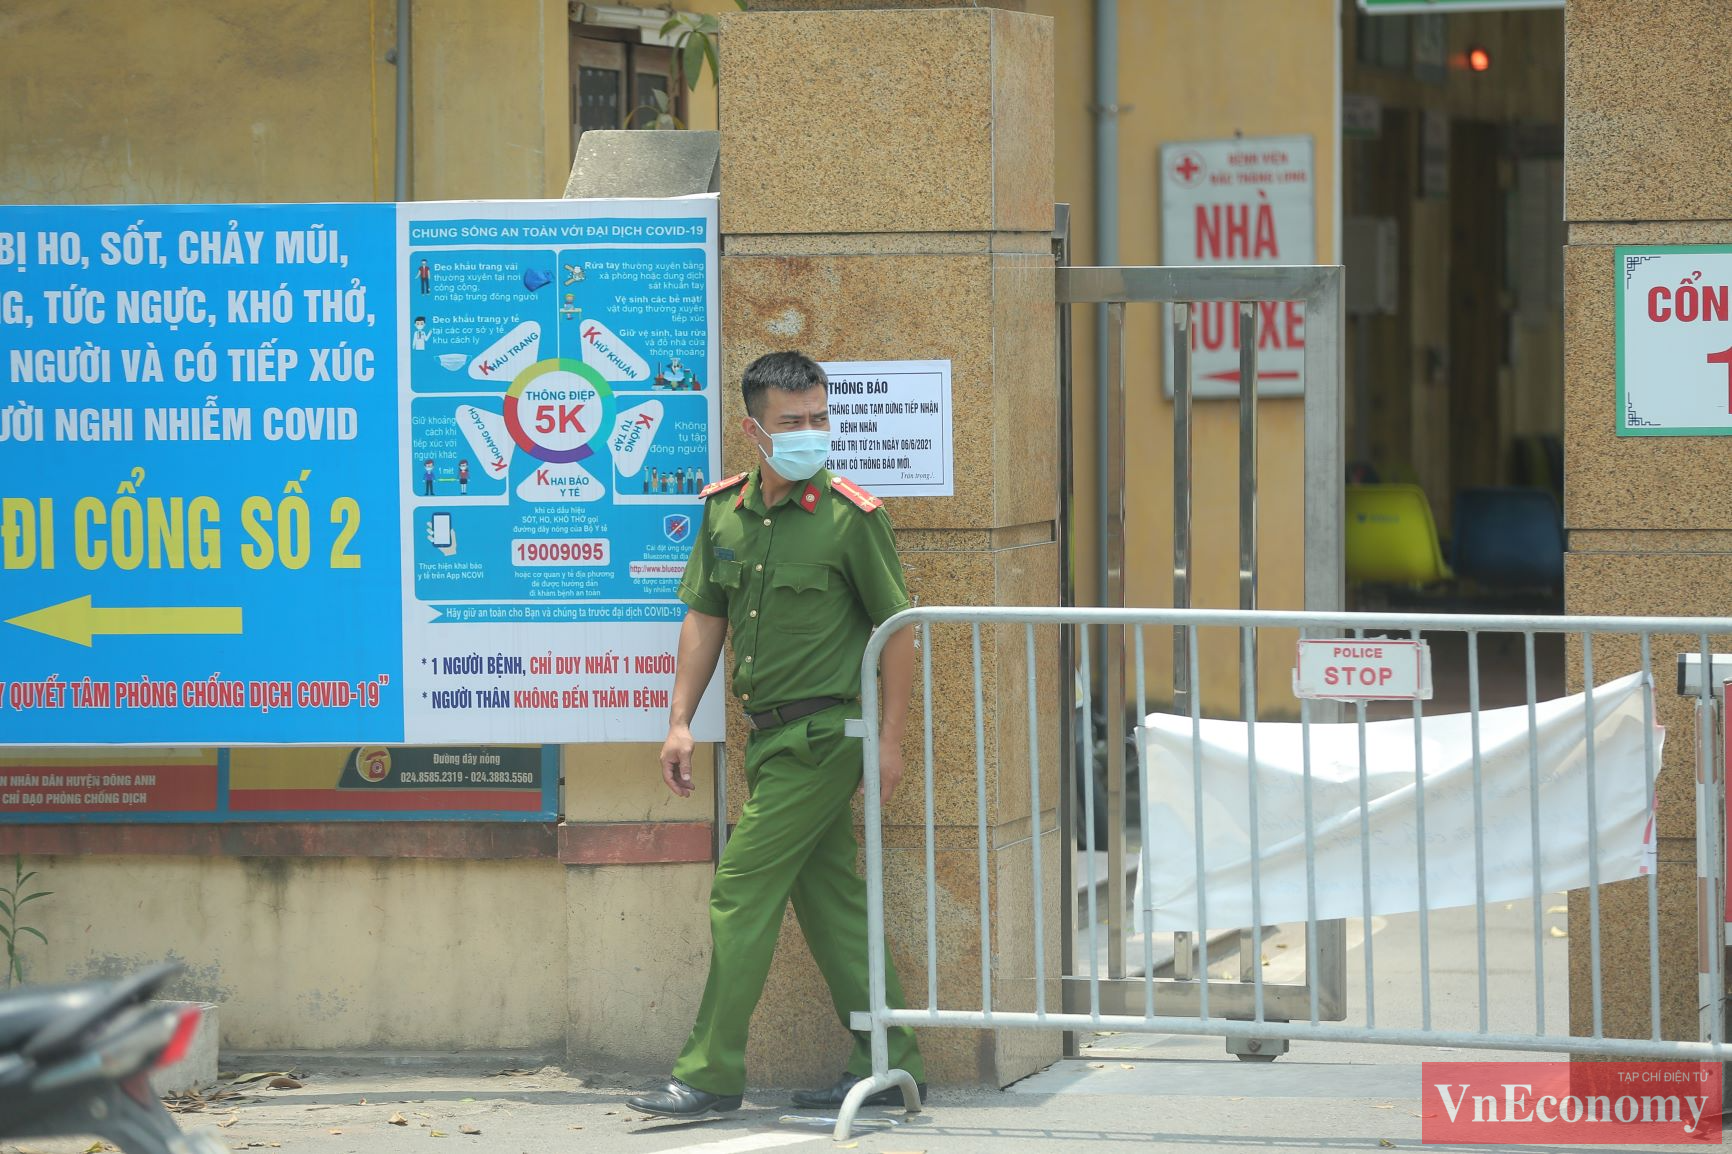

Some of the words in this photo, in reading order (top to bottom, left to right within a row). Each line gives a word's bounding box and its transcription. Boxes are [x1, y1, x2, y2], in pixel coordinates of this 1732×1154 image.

[412, 228, 458, 239] CHUNG
[501, 227, 519, 237] AN
[587, 226, 608, 238] ĐẠI
[612, 226, 642, 238] DỊCH
[645, 225, 704, 236] COVID-19
[1195, 189, 1279, 259] NHÀ
[0, 231, 26, 272] BỊ
[37, 231, 90, 269] HO,
[100, 219, 167, 269] SỐT,
[178, 219, 264, 265] CHẢY
[275, 223, 348, 268] MŨI,
[0, 290, 33, 328] G,
[44, 283, 105, 324] TỨC
[116, 287, 217, 331] NGỰC,
[227, 282, 293, 324] KHÓ
[303, 277, 375, 327] THỞ,
[1648, 271, 1729, 322] CỔN
[508, 332, 539, 357] TRANG
[10, 341, 111, 383] NGƯỜI
[121, 342, 164, 383] VÀ
[174, 341, 217, 383] CÓ
[227, 337, 298, 382] TIẾP
[309, 341, 375, 382] XÚC
[527, 389, 565, 401] THÔNG
[569, 390, 595, 402] ĐIỆP
[829, 379, 863, 394] THÔNG
[867, 379, 888, 394] BÁO
[852, 403, 868, 415] LONG
[870, 403, 884, 417] TẠM
[905, 399, 919, 413] TIẾP
[55, 407, 133, 442] NGHI
[144, 395, 251, 441] NHIỄM
[263, 407, 358, 441] COVID
[535, 404, 586, 433] 5K
[840, 420, 857, 435] BỆNH
[848, 440, 858, 453] TRỊ
[869, 440, 880, 451] 21h
[901, 438, 932, 450] 06/6/2021
[825, 456, 835, 470] ẾN
[836, 459, 847, 469] KHI
[849, 456, 858, 469] CÓ
[860, 456, 880, 469] THÔNG
[882, 456, 896, 469] BÁO
[1, 497, 54, 570] ĐI
[74, 466, 221, 570] CỔNG
[240, 469, 312, 570] SỐ
[330, 496, 361, 569] 2
[517, 543, 604, 561] 19009095
[509, 608, 522, 617] cho
[525, 608, 540, 619] Bạn
[579, 608, 586, 617] ta
[612, 607, 624, 619] đại
[626, 607, 642, 619] dịch
[645, 607, 681, 617] COVID-19
[1333, 647, 1383, 659] POLICE
[431, 658, 438, 674] 1
[443, 653, 484, 675] NGƯỜI
[488, 653, 526, 678] BỆNH,
[530, 651, 552, 674] CHỈ
[556, 656, 581, 674] DUY
[585, 650, 620, 674] NHẤT
[624, 656, 630, 674] 1
[635, 651, 676, 674] NGƯỜI
[1324, 666, 1393, 686] STOP
[10, 673, 67, 712] QUYẾT
[71, 675, 110, 709] TÂM
[115, 675, 177, 708] PHÒNG
[182, 672, 245, 708] CHỐNG
[251, 682, 293, 713] DỊCH
[432, 686, 473, 709] NGƯỜI
[476, 687, 510, 708] THÂN
[514, 687, 559, 708] KHÔNG
[562, 684, 589, 708] ĐẾN
[592, 686, 630, 708] THĂM
[633, 686, 669, 711] BỆNH
[433, 753, 459, 765] Đường
[462, 753, 478, 766] dây
[480, 754, 500, 766] nóng
[10, 774, 39, 787] NHÂN
[42, 774, 63, 787] DÂN
[66, 774, 100, 788] HUYỆN
[134, 775, 156, 786] ANH
[400, 772, 463, 783] 024.8585.2319
[471, 772, 533, 783] 024.3883.5560
[22, 793, 43, 806] ĐẠO
[84, 790, 119, 804] CHỐNG
[122, 793, 147, 806] DỊCH
